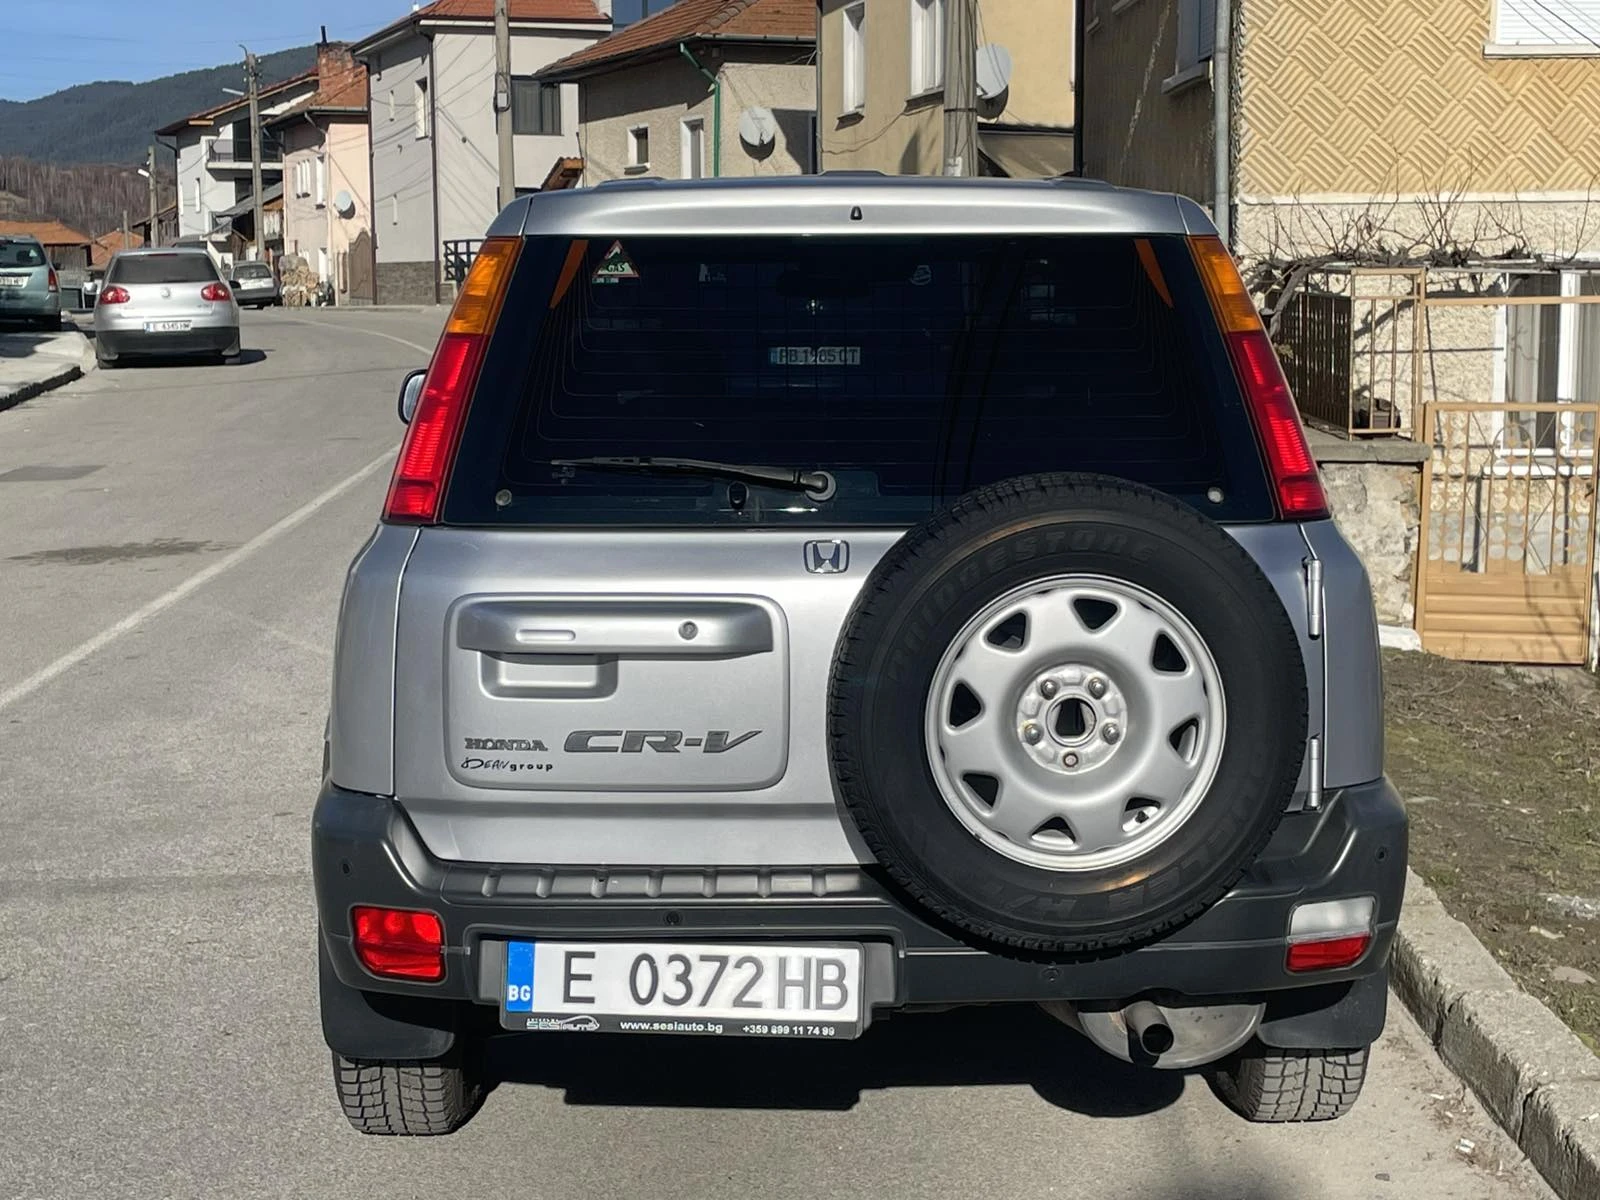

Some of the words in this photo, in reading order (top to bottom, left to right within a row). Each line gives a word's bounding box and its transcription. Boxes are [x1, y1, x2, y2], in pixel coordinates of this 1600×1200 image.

[607, 262, 626, 273] GAS
[464, 737, 548, 751] HONDA
[563, 730, 762, 753] CR-V
[563, 951, 596, 1003] E
[508, 986, 531, 1002] BG
[742, 1025, 769, 1035] +359
[792, 1026, 804, 1036] 11
[807, 1026, 820, 1036] 74
